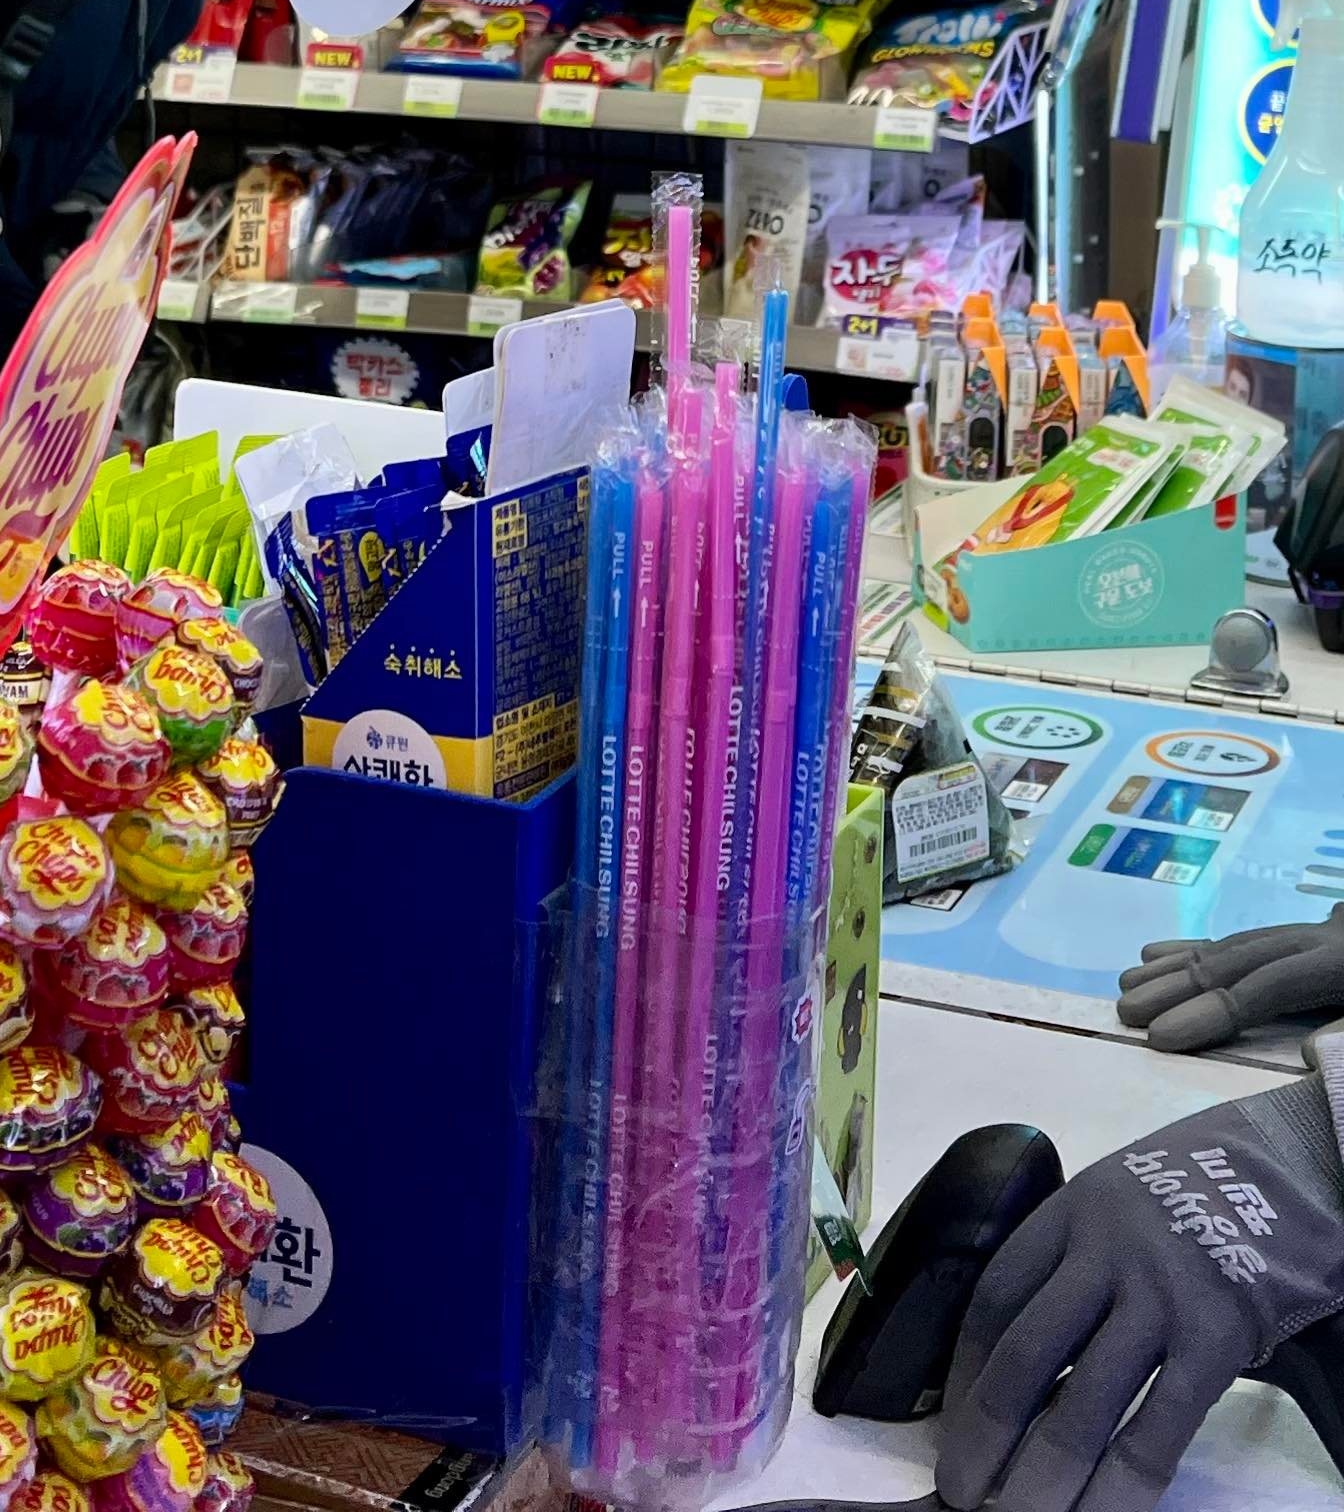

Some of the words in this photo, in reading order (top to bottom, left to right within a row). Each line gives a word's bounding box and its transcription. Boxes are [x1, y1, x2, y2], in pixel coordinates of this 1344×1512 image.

[895, 12, 1006, 45] Trolli
[314, 51, 353, 67] NEW
[553, 64, 592, 80] NEW
[831, 253, 903, 287] 자두
[734, 474, 746, 523] PULL
[612, 531, 626, 577] PULL
[638, 540, 654, 588] PULL
[814, 550, 828, 599] PULL
[383, 652, 463, 680] 숙취해소
[386, 734, 410, 751] 큐원
[725, 684, 743, 752] LOTTE
[599, 735, 617, 798] LOTTE
[625, 745, 644, 810] LOTTE
[28, 820, 102, 871] Chupa
[716, 754, 739, 892] CHILSUNG
[595, 799, 615, 940] CHILSUNG
[618, 813, 641, 951] CHILSUNG
[1122, 1148, 1269, 1286] 칠성사이다
[13, 1320, 85, 1360] Chupa
